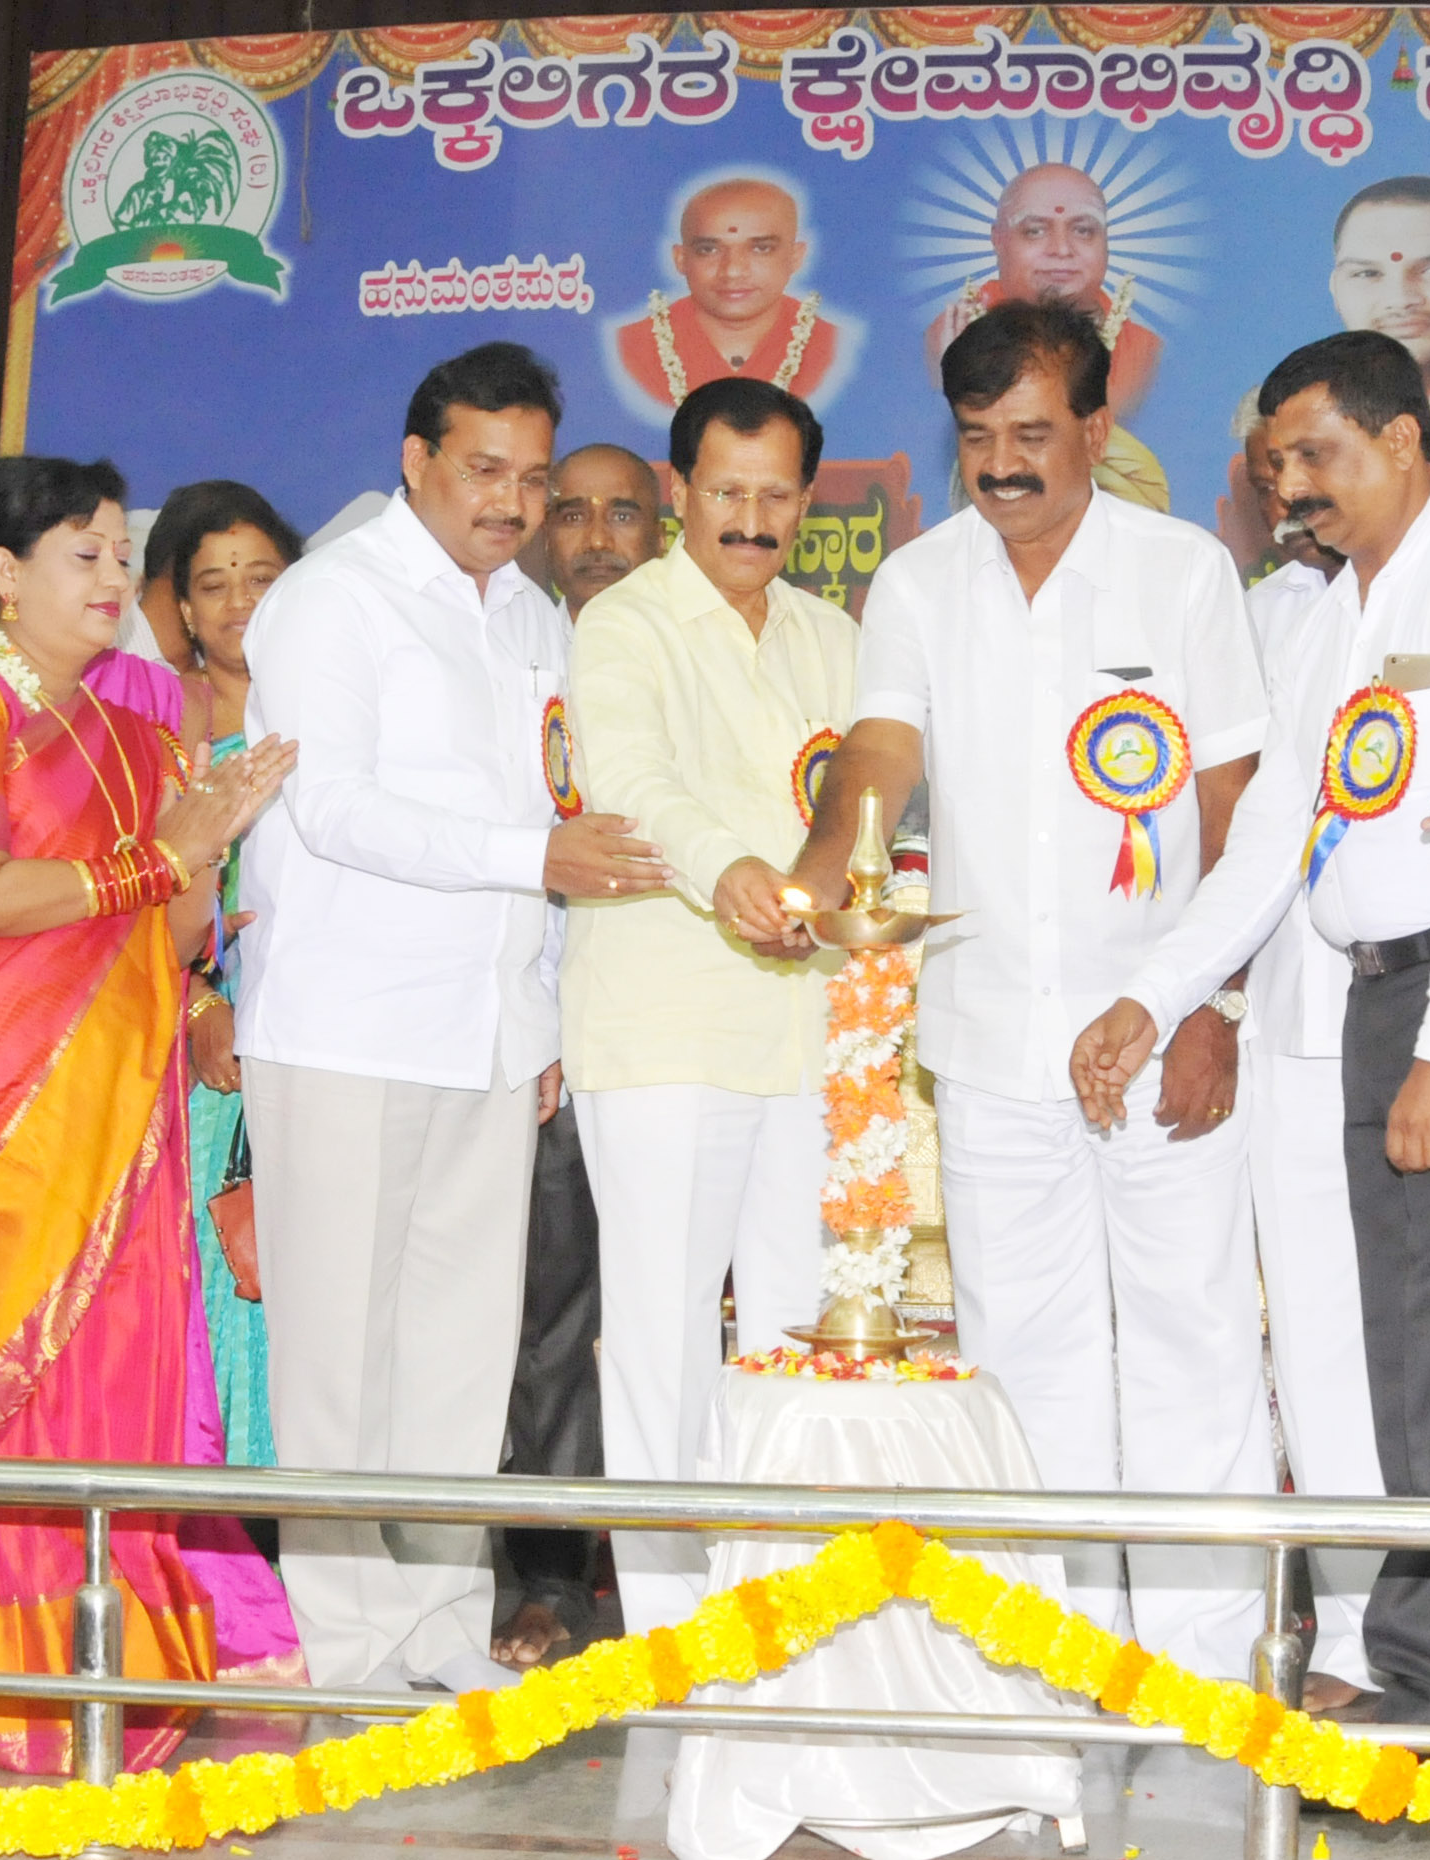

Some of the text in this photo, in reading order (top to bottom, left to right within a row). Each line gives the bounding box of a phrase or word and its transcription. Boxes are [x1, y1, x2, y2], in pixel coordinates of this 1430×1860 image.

[340, 36, 735, 166] ಒಕ್ಕಲಿಗರ
[786, 29, 1366, 161] ಕ್ಷೇಮಾಭಿವೃದ್ಧಿ
[81, 128, 115, 205] ಒಕ್ಕಲಿಗರ
[122, 263, 216, 283] ಹನುಮಂತಪುರ
[362, 257, 591, 312] ಹನುಮಂತಪುರ,
[786, 496, 884, 608] ಸ್ಕಾರ
